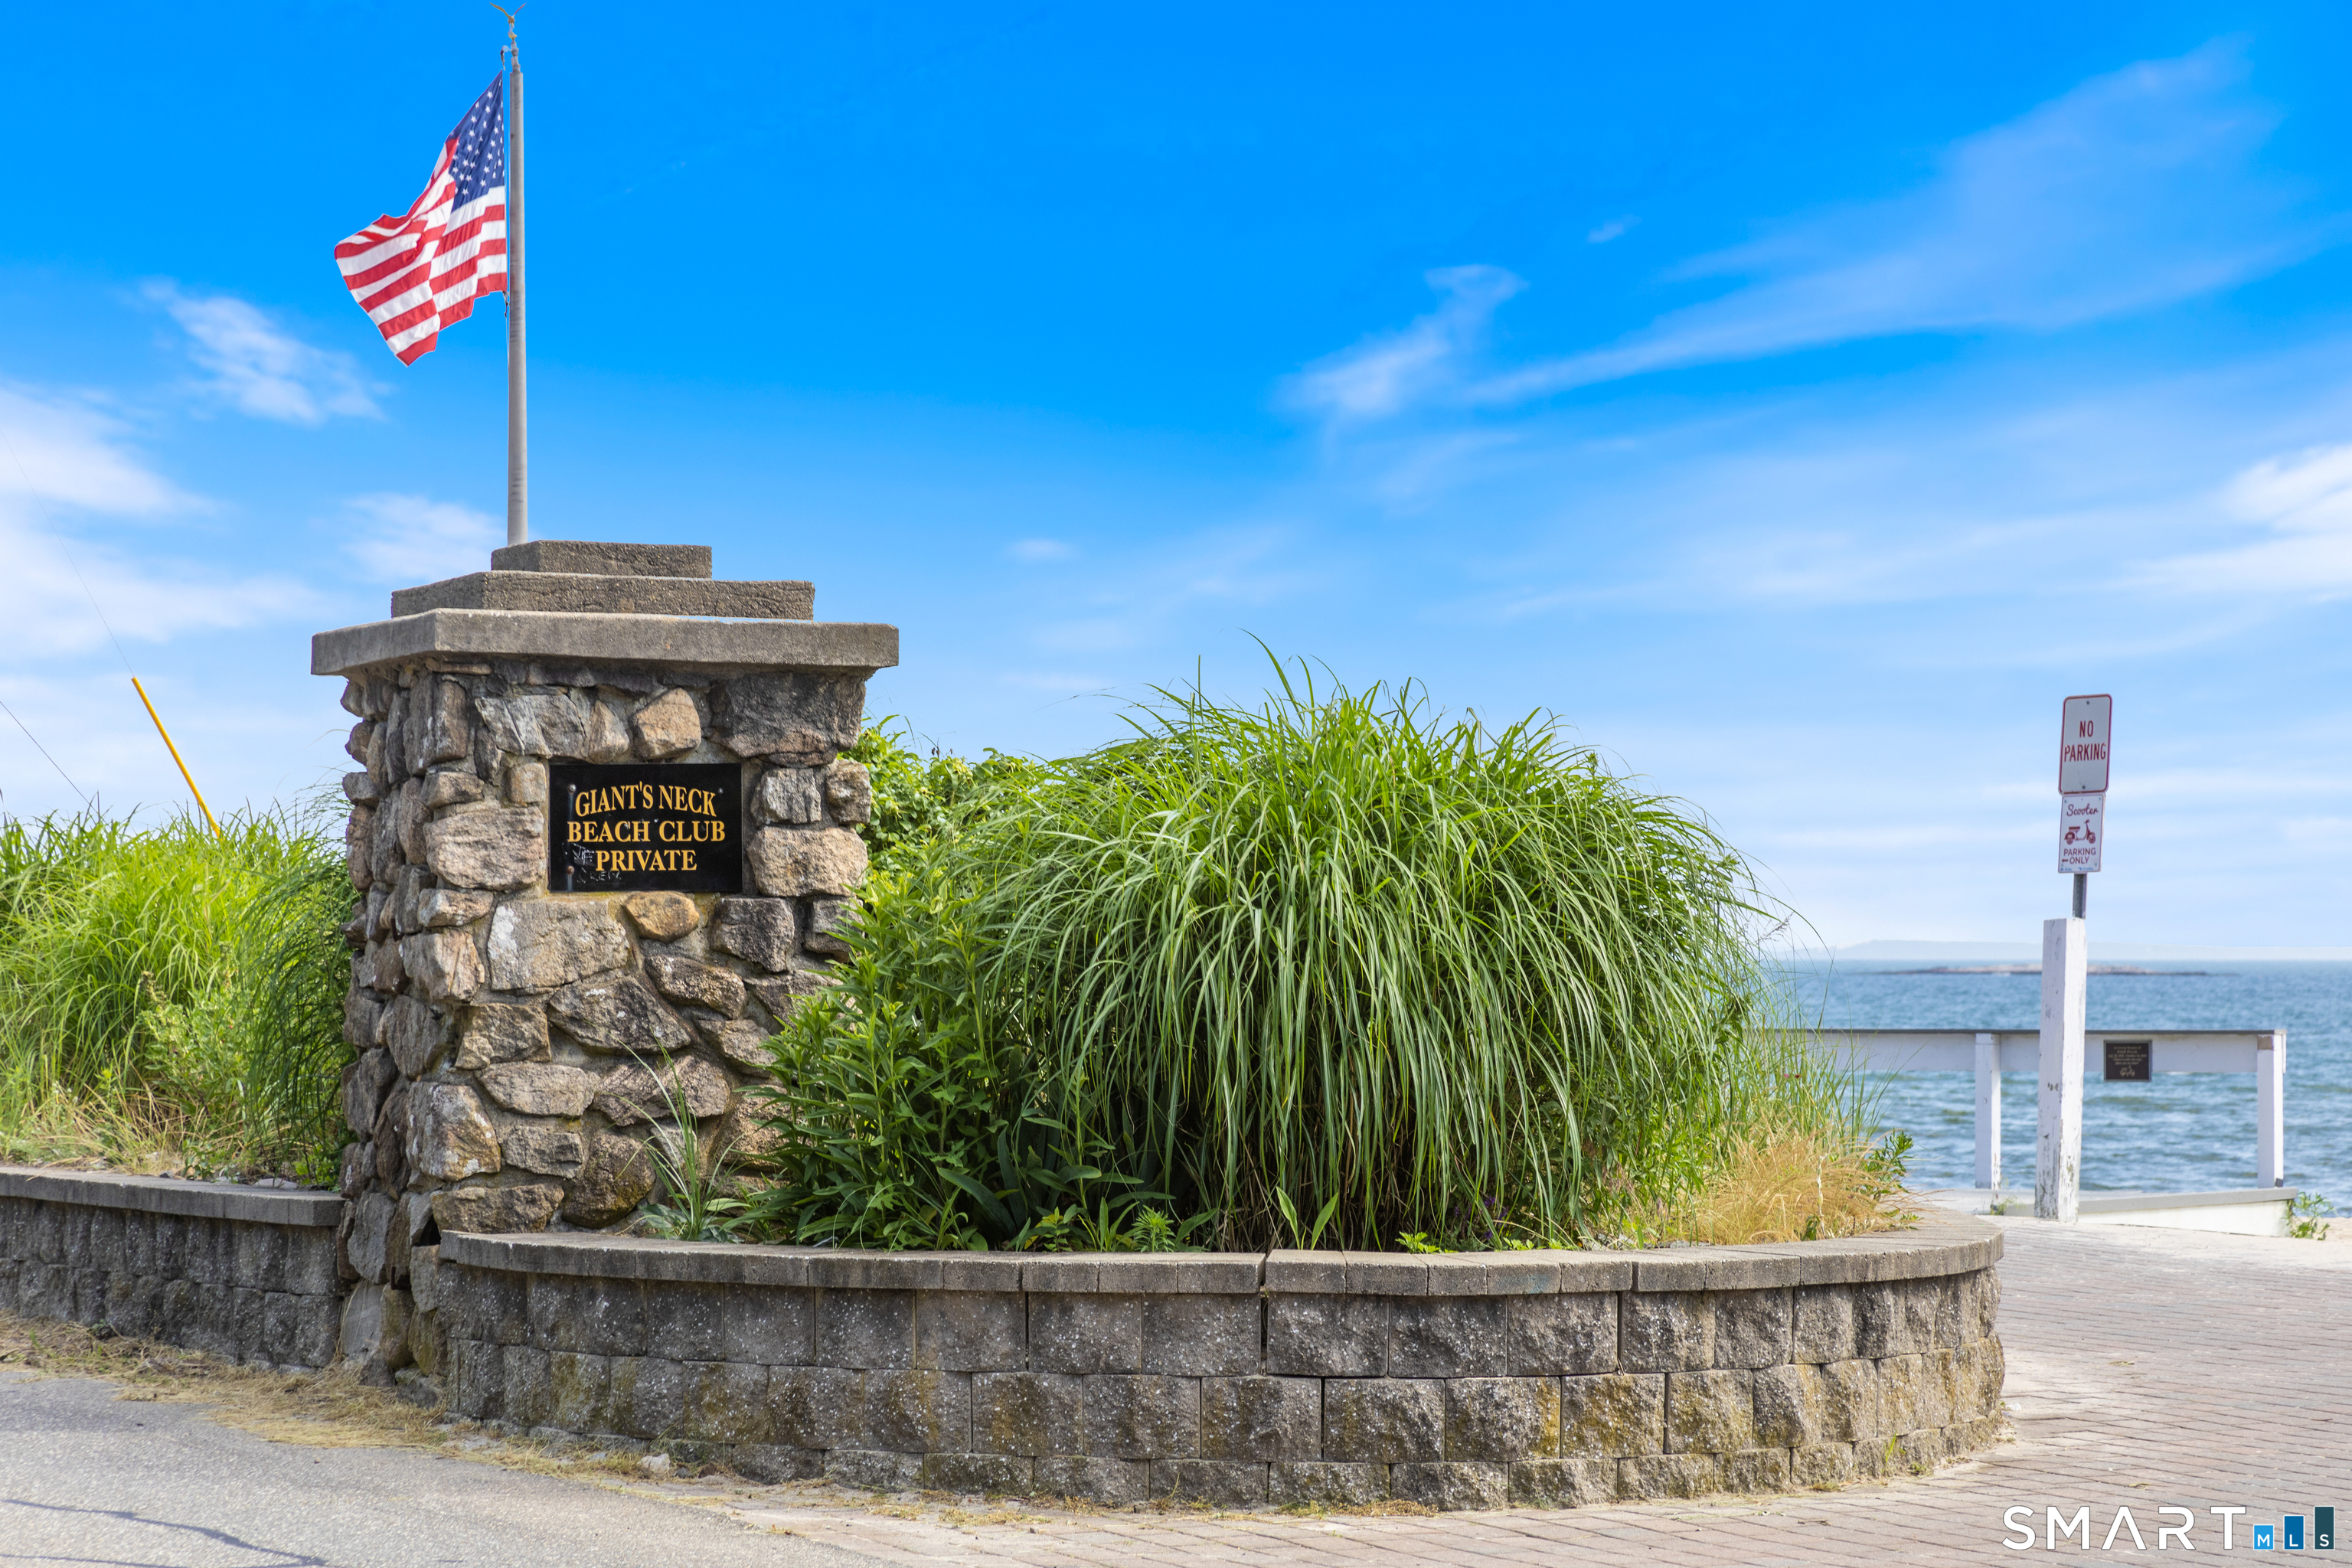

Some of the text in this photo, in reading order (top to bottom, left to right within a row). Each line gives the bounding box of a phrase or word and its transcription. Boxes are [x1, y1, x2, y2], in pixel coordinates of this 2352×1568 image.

[2079, 720, 2094, 738] NO
[2064, 743, 2106, 762] PARKING
[575, 781, 717, 817] GIANT'S NECK
[2066, 803, 2099, 817] Scooter
[567, 820, 726, 842] BEACH CLUB
[595, 850, 697, 871] PRIVATE
[2063, 848, 2096, 857] PARKING
